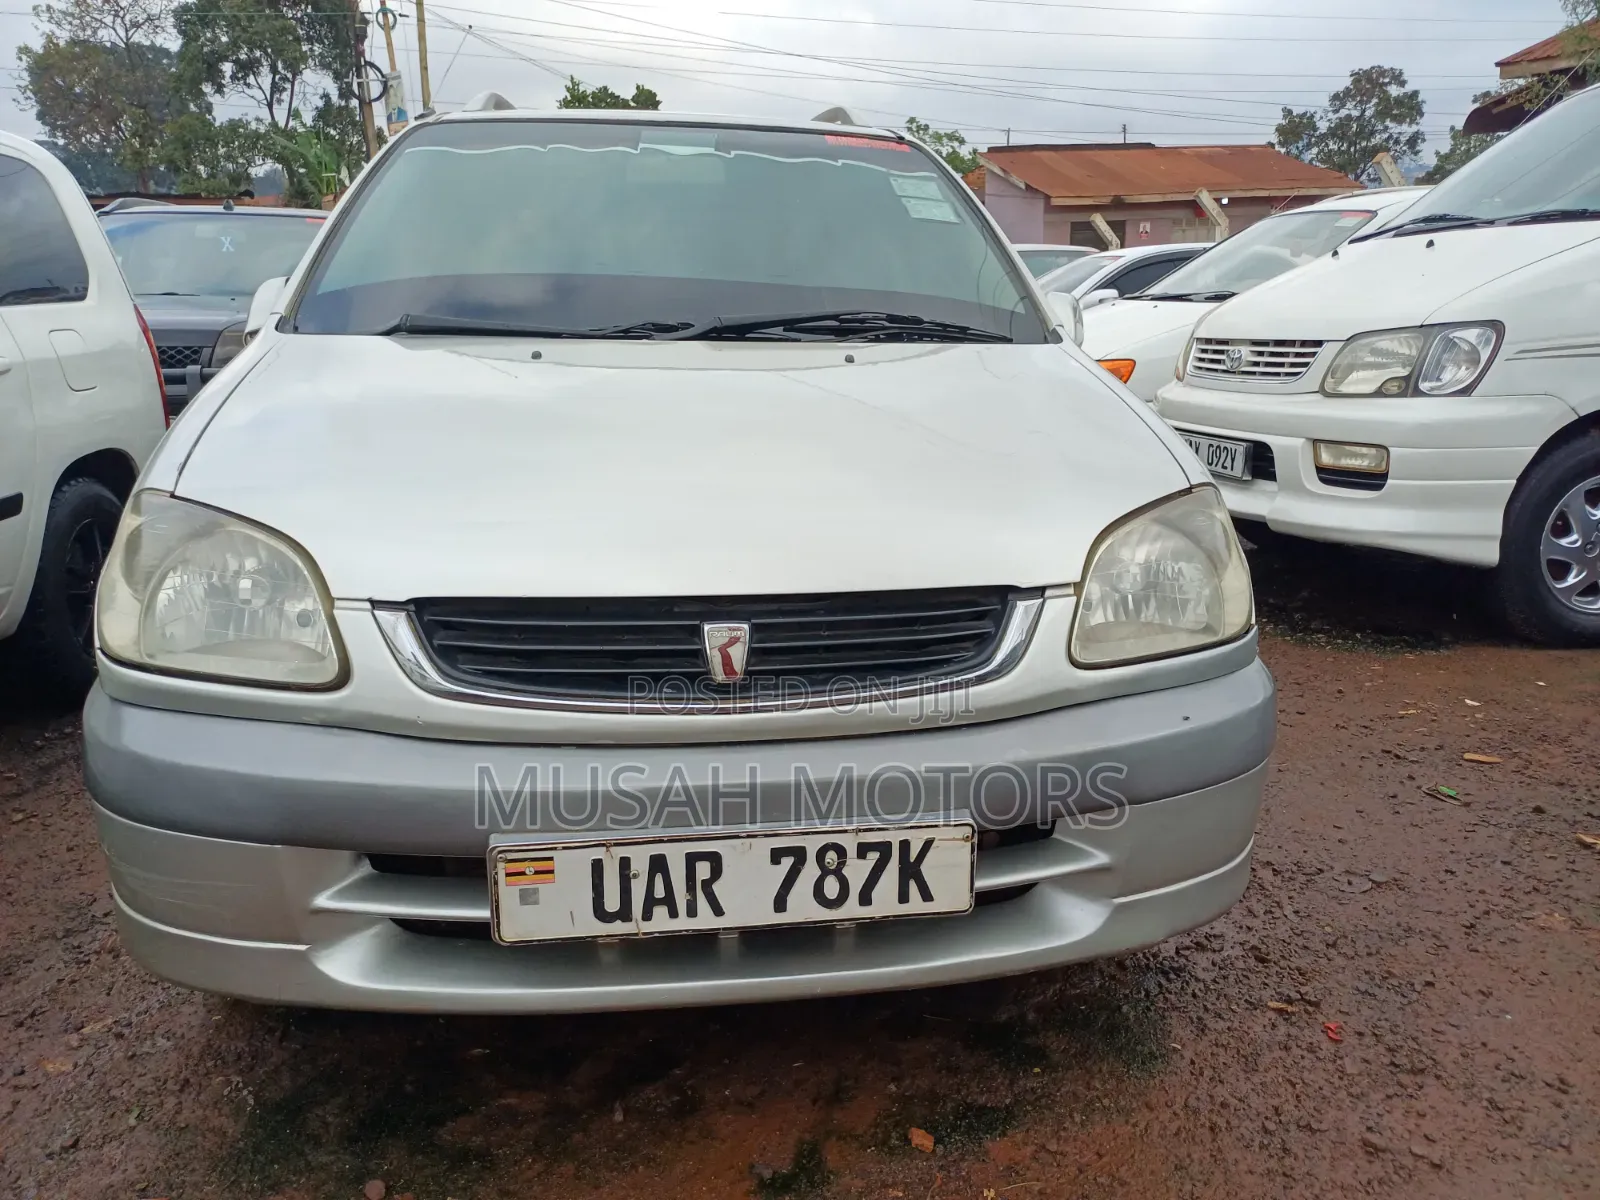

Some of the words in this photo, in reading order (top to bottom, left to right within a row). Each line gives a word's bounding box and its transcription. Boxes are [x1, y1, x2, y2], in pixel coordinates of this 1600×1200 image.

[1206, 443, 1237, 472] 092Y
[591, 851, 725, 923] UAR
[770, 837, 935, 913] 787K
